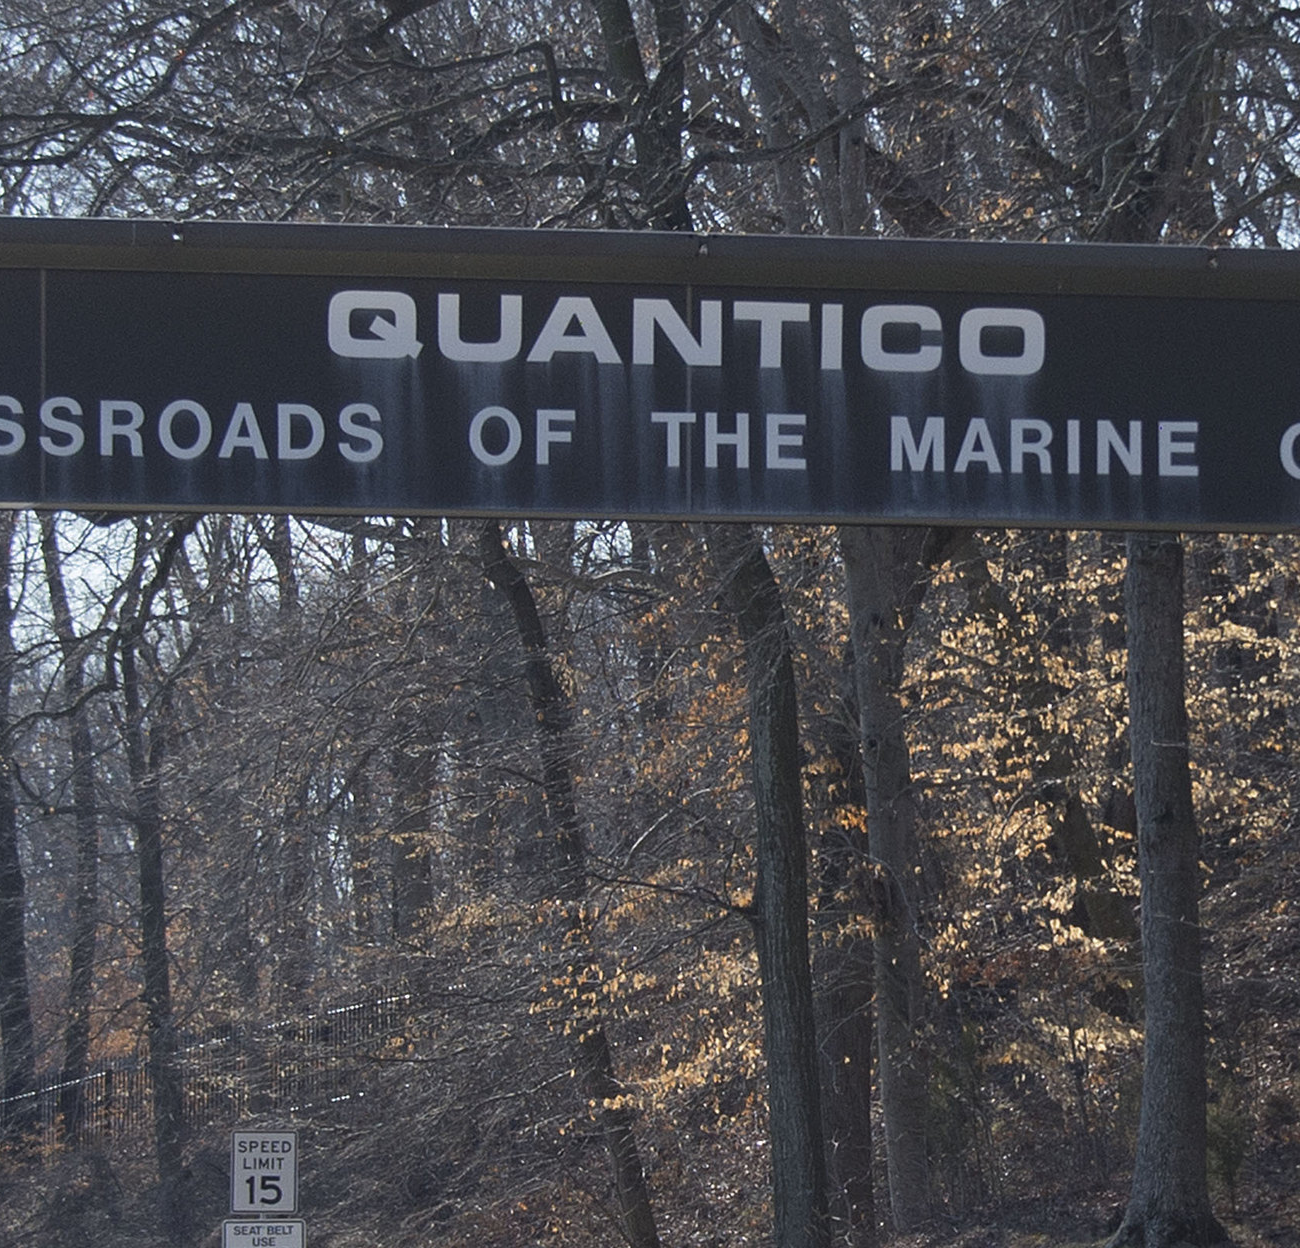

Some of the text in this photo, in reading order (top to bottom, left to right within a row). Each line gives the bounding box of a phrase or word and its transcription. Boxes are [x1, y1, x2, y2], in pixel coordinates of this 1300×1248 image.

[327, 289, 1046, 377] QUANTICO
[468, 405, 577, 467] OF
[650, 411, 808, 471] THE
[889, 415, 1200, 477] MARINE
[238, 1140, 292, 1154] SPEED
[243, 1157, 285, 1170] LIMIT
[245, 1175, 283, 1205] 15
[233, 1225, 294, 1236] SEAT BELT
[252, 1237, 276, 1247] USE
